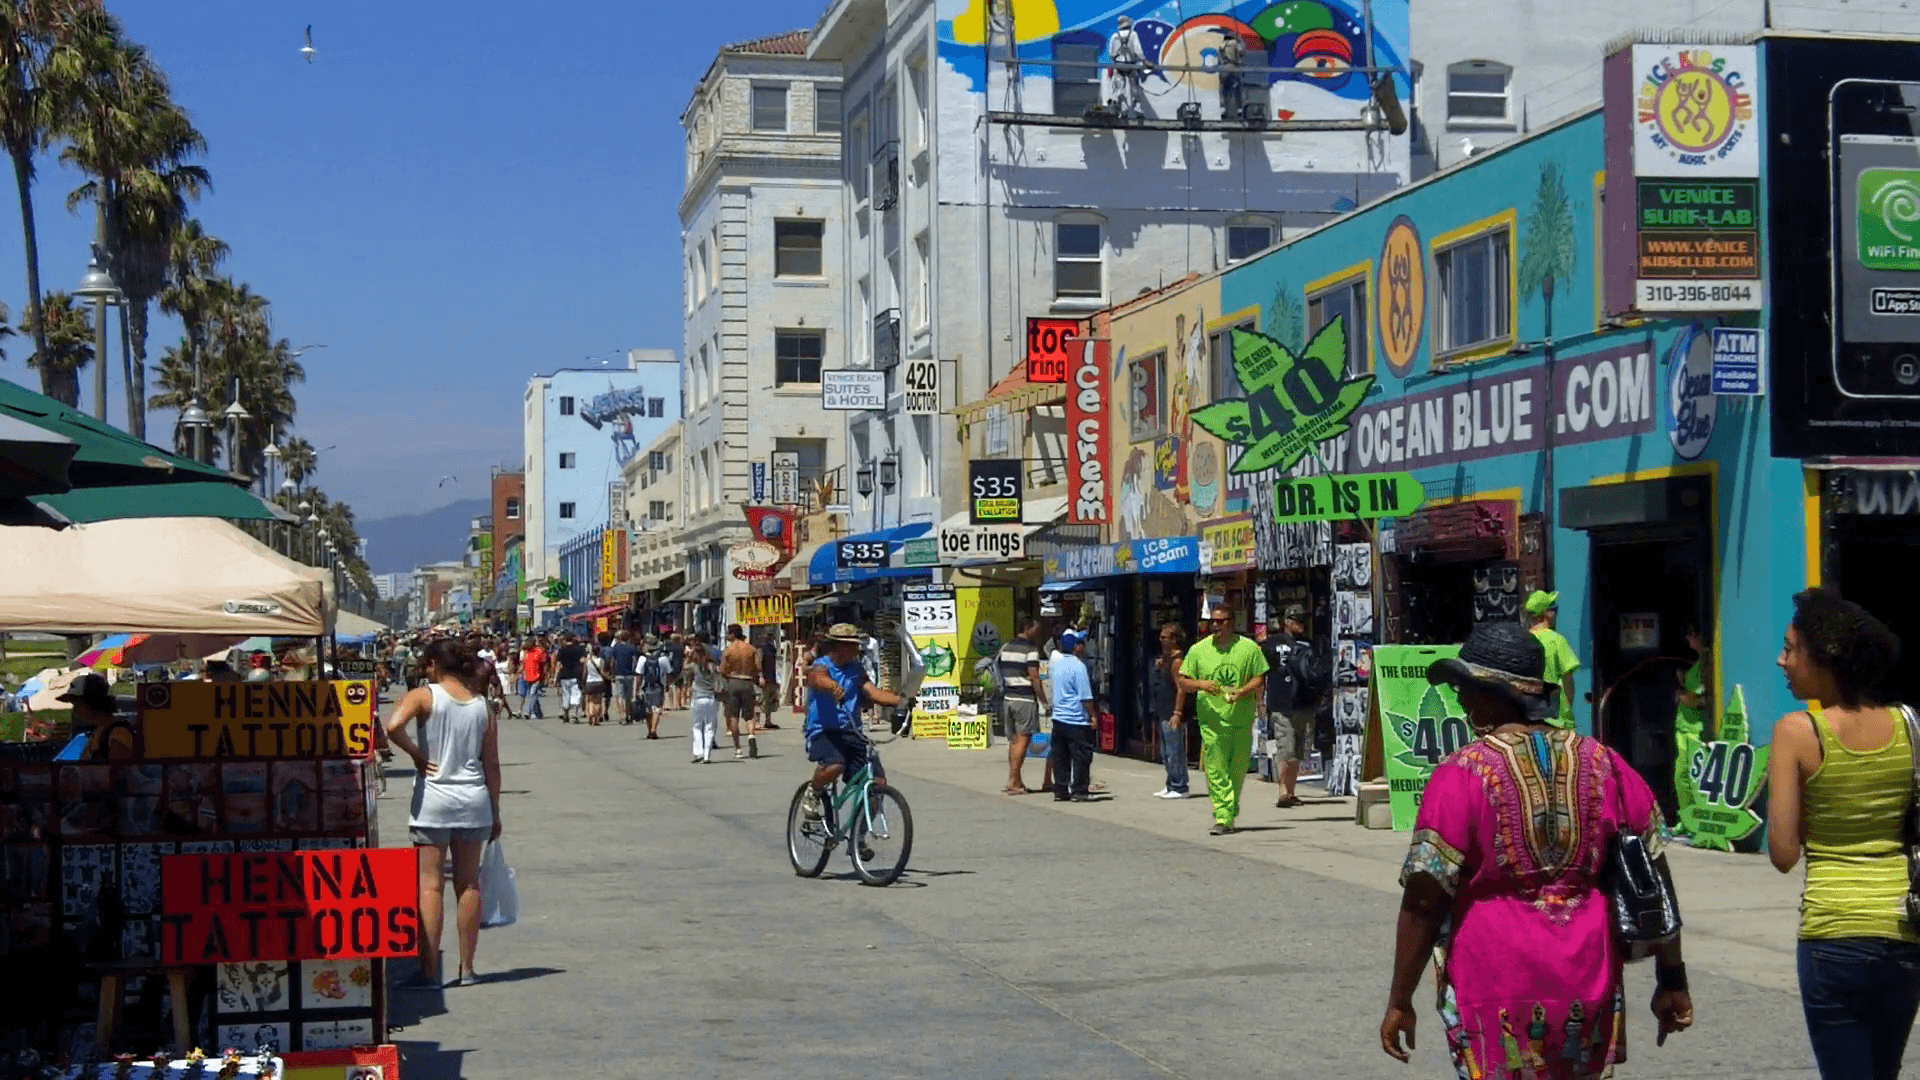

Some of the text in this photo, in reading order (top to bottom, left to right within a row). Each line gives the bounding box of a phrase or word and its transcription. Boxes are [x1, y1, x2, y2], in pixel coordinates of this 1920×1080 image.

[1659, 188, 1735, 204] VENICE
[1643, 208, 1753, 224] SURF-LAB
[1645, 286, 1752, 301] 310-396-8044
[1716, 333, 1756, 353] ATM
[1714, 354, 1757, 363] MACHINE
[856, 374, 883, 382] BEACH
[905, 362, 937, 390] 420
[825, 384, 871, 394] SUITES
[1226, 357, 1342, 441] $40
[839, 396, 884, 406] HOTEL
[906, 392, 937, 412] DOCTOR
[1357, 397, 1444, 468] OCEAN
[1452, 378, 1533, 451] BLUE
[1557, 353, 1651, 434] .COM
[973, 475, 1016, 498] $35
[1277, 478, 1399, 516] DR. IS IN
[841, 543, 885, 559] $35
[941, 528, 970, 552] toe
[976, 527, 1020, 557] rings
[1141, 545, 1189, 569] cream
[907, 605, 953, 622] $35
[1380, 665, 1429, 679] THE GREE
[214, 683, 344, 719] HENNA
[922, 699, 950, 710] PRICES
[187, 722, 370, 756] TATTOOS
[948, 718, 962, 737] toe
[963, 720, 986, 741] rings
[1402, 716, 1471, 764] $40
[1390, 778, 1427, 792] MEDIC
[1691, 743, 1755, 808] $40
[201, 852, 379, 904] HENNA
[163, 905, 417, 961] TATTOOS
